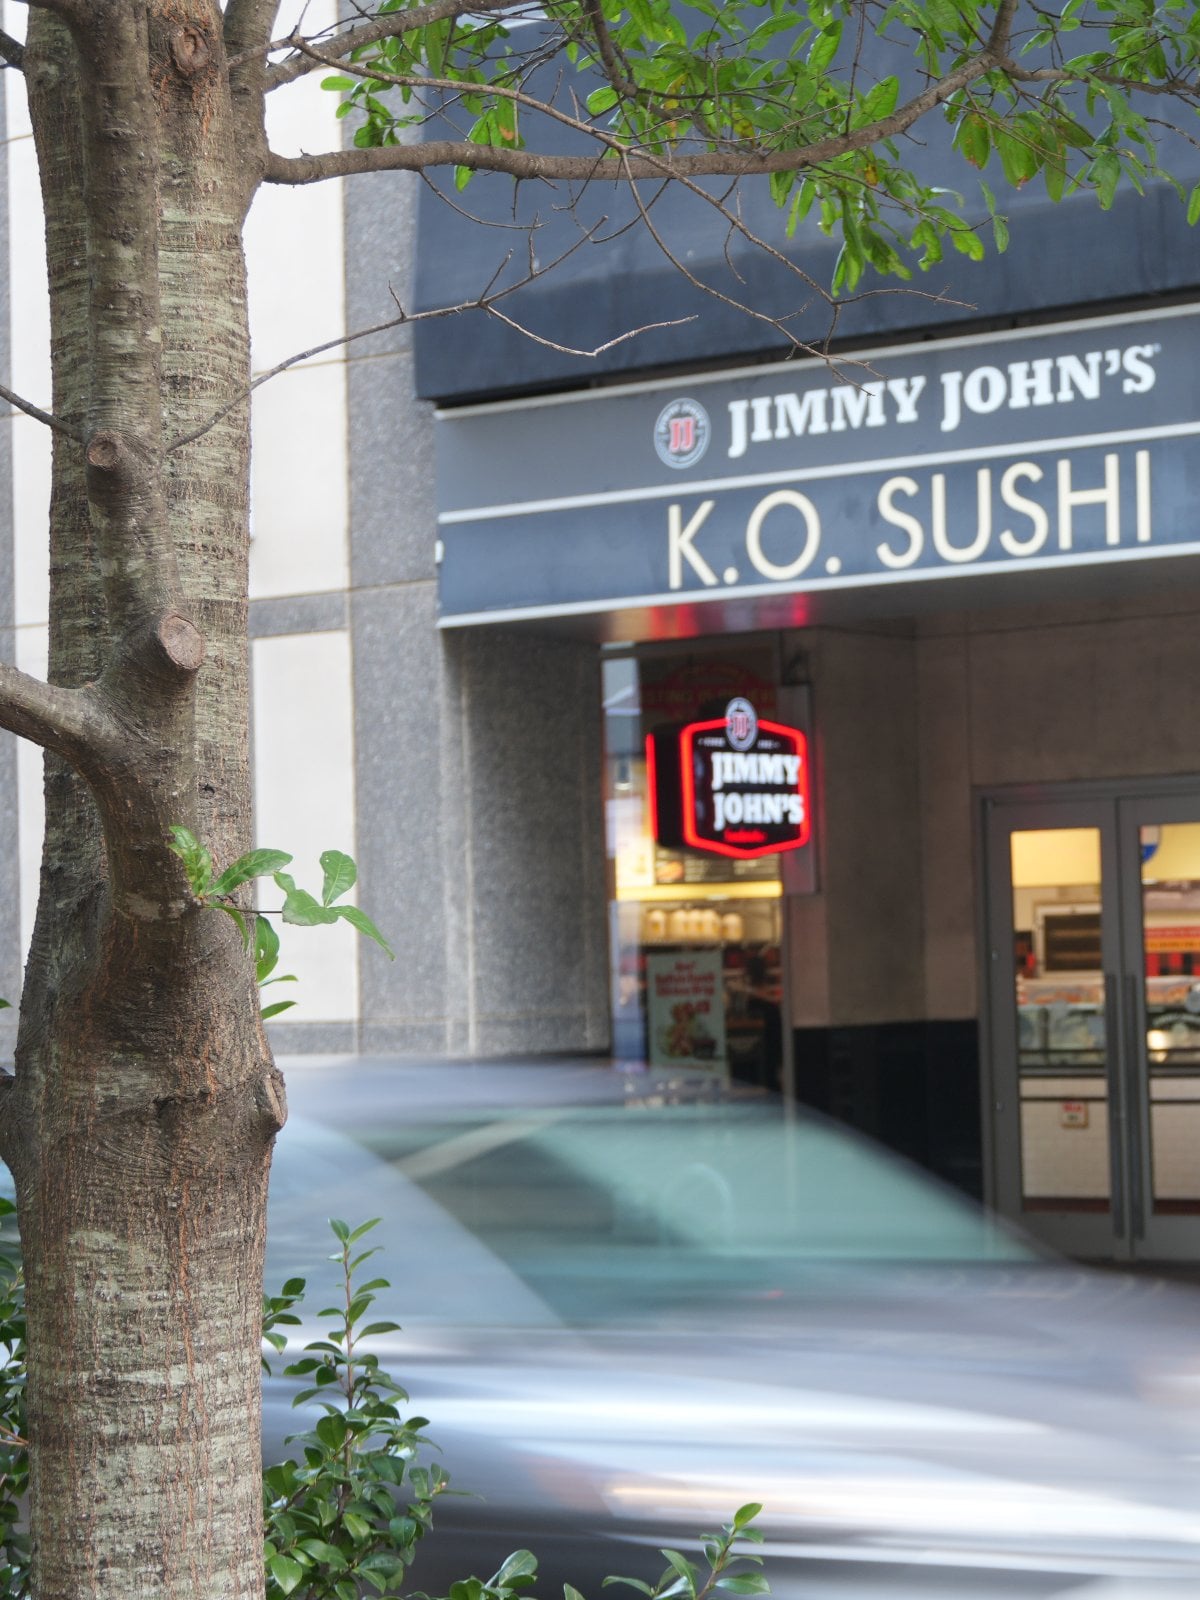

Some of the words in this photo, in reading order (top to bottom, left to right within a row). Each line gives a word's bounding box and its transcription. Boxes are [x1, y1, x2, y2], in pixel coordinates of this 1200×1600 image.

[727, 375, 926, 459] JIMMY
[940, 345, 1156, 433] JOHN'S
[667, 489, 841, 591] K.O.
[875, 449, 1152, 570] SUSHI
[711, 751, 801, 790] JIMMY
[713, 791, 804, 831] JOHN'S
